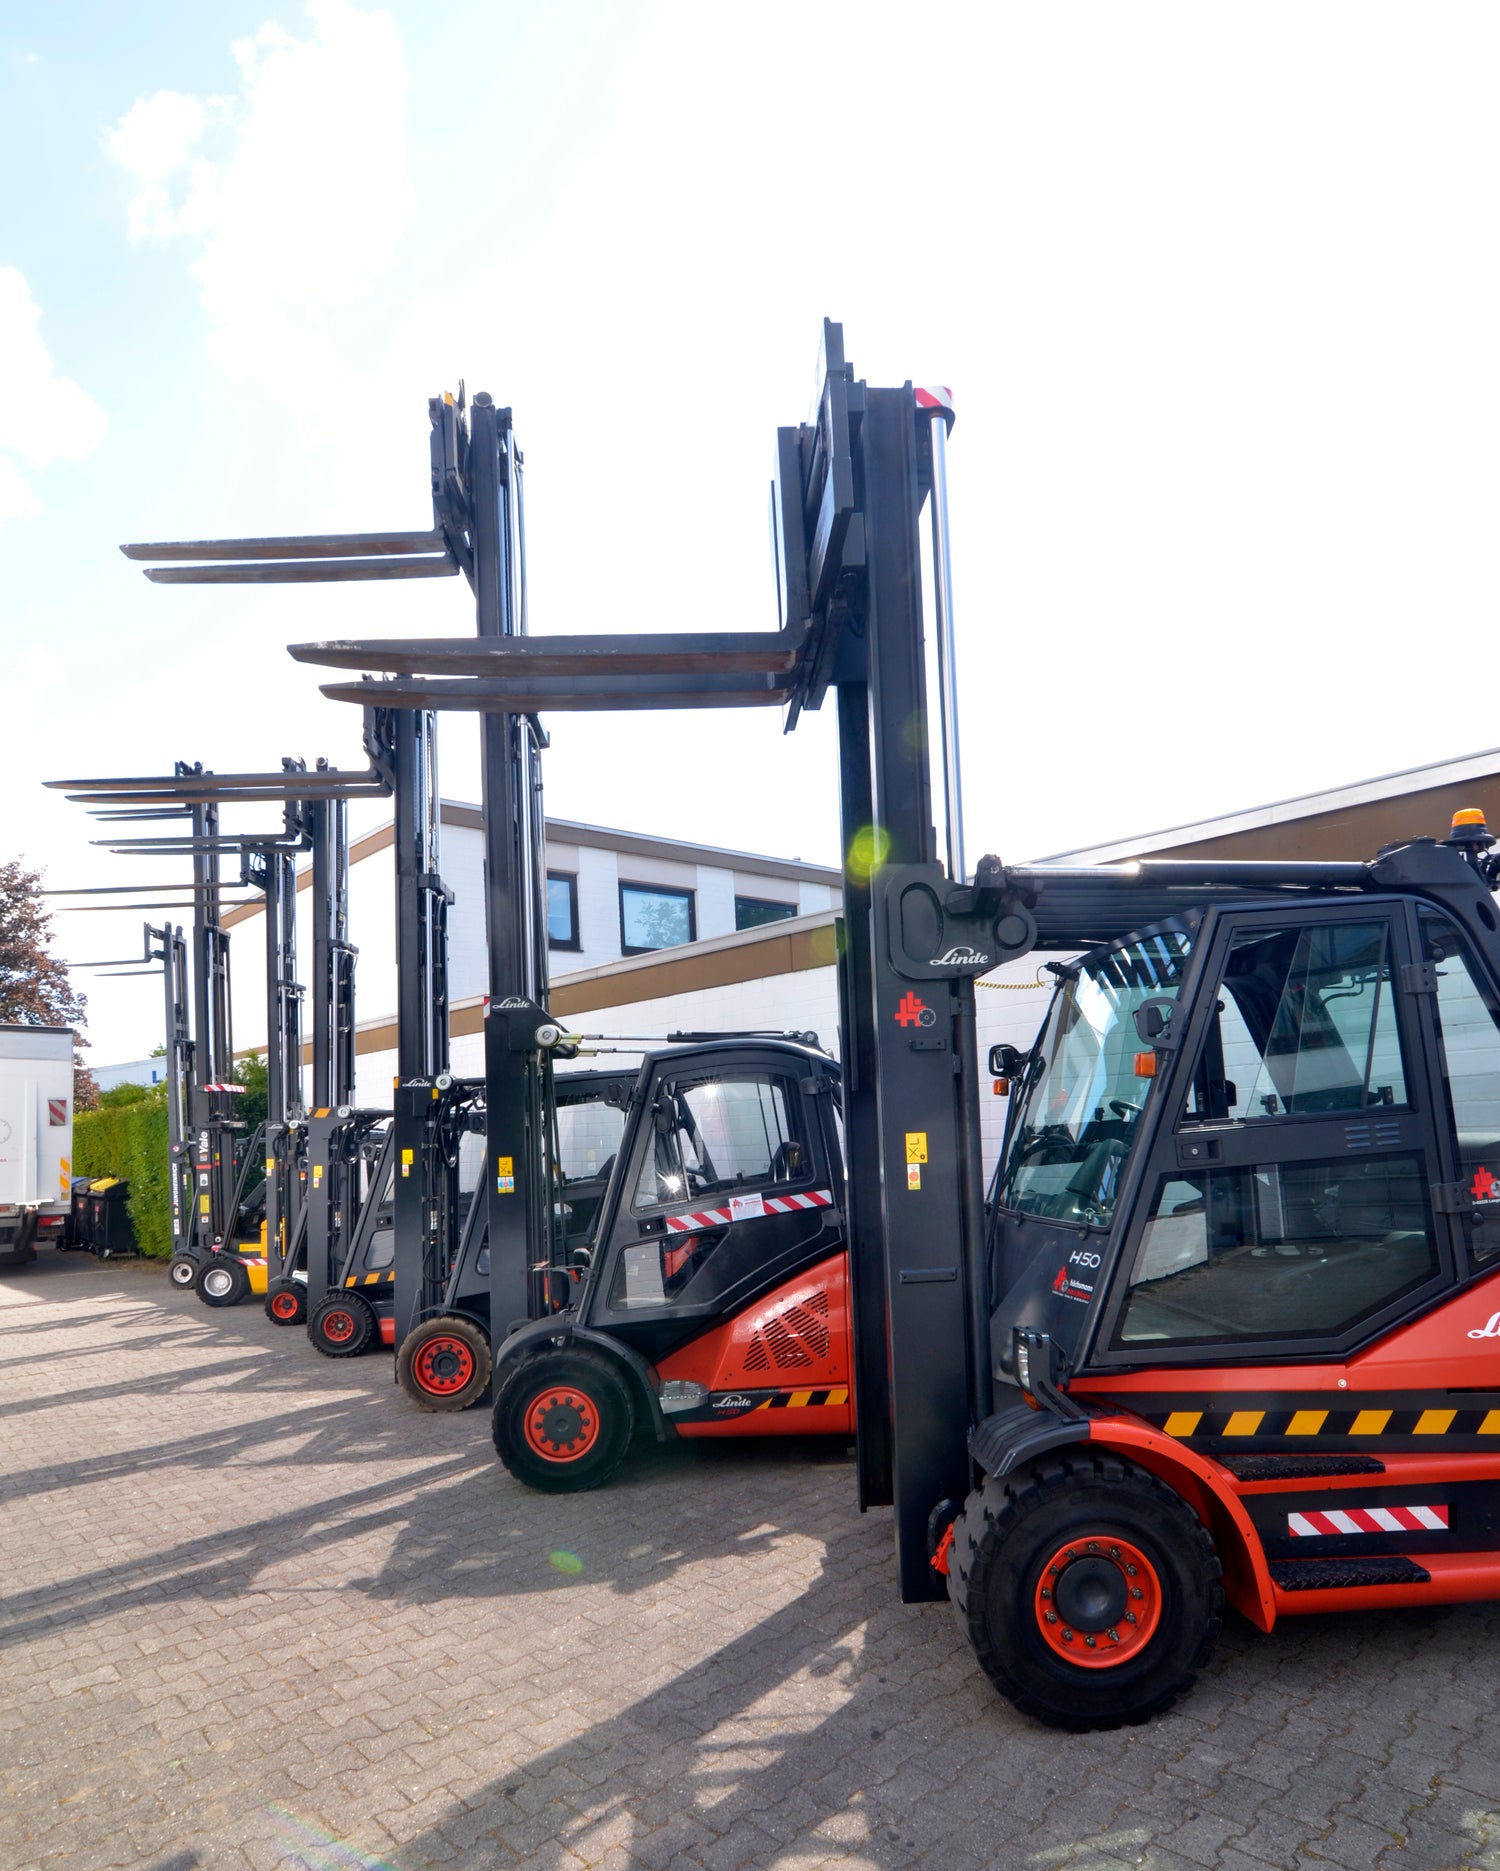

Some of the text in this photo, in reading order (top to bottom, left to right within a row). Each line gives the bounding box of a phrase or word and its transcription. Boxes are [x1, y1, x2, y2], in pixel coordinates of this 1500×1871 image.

[929, 946, 989, 966] Linde
[492, 996, 530, 1009] Linde
[401, 1077, 432, 1087] Linde
[1068, 1250, 1101, 1268] H50
[712, 1394, 752, 1408] Linde
